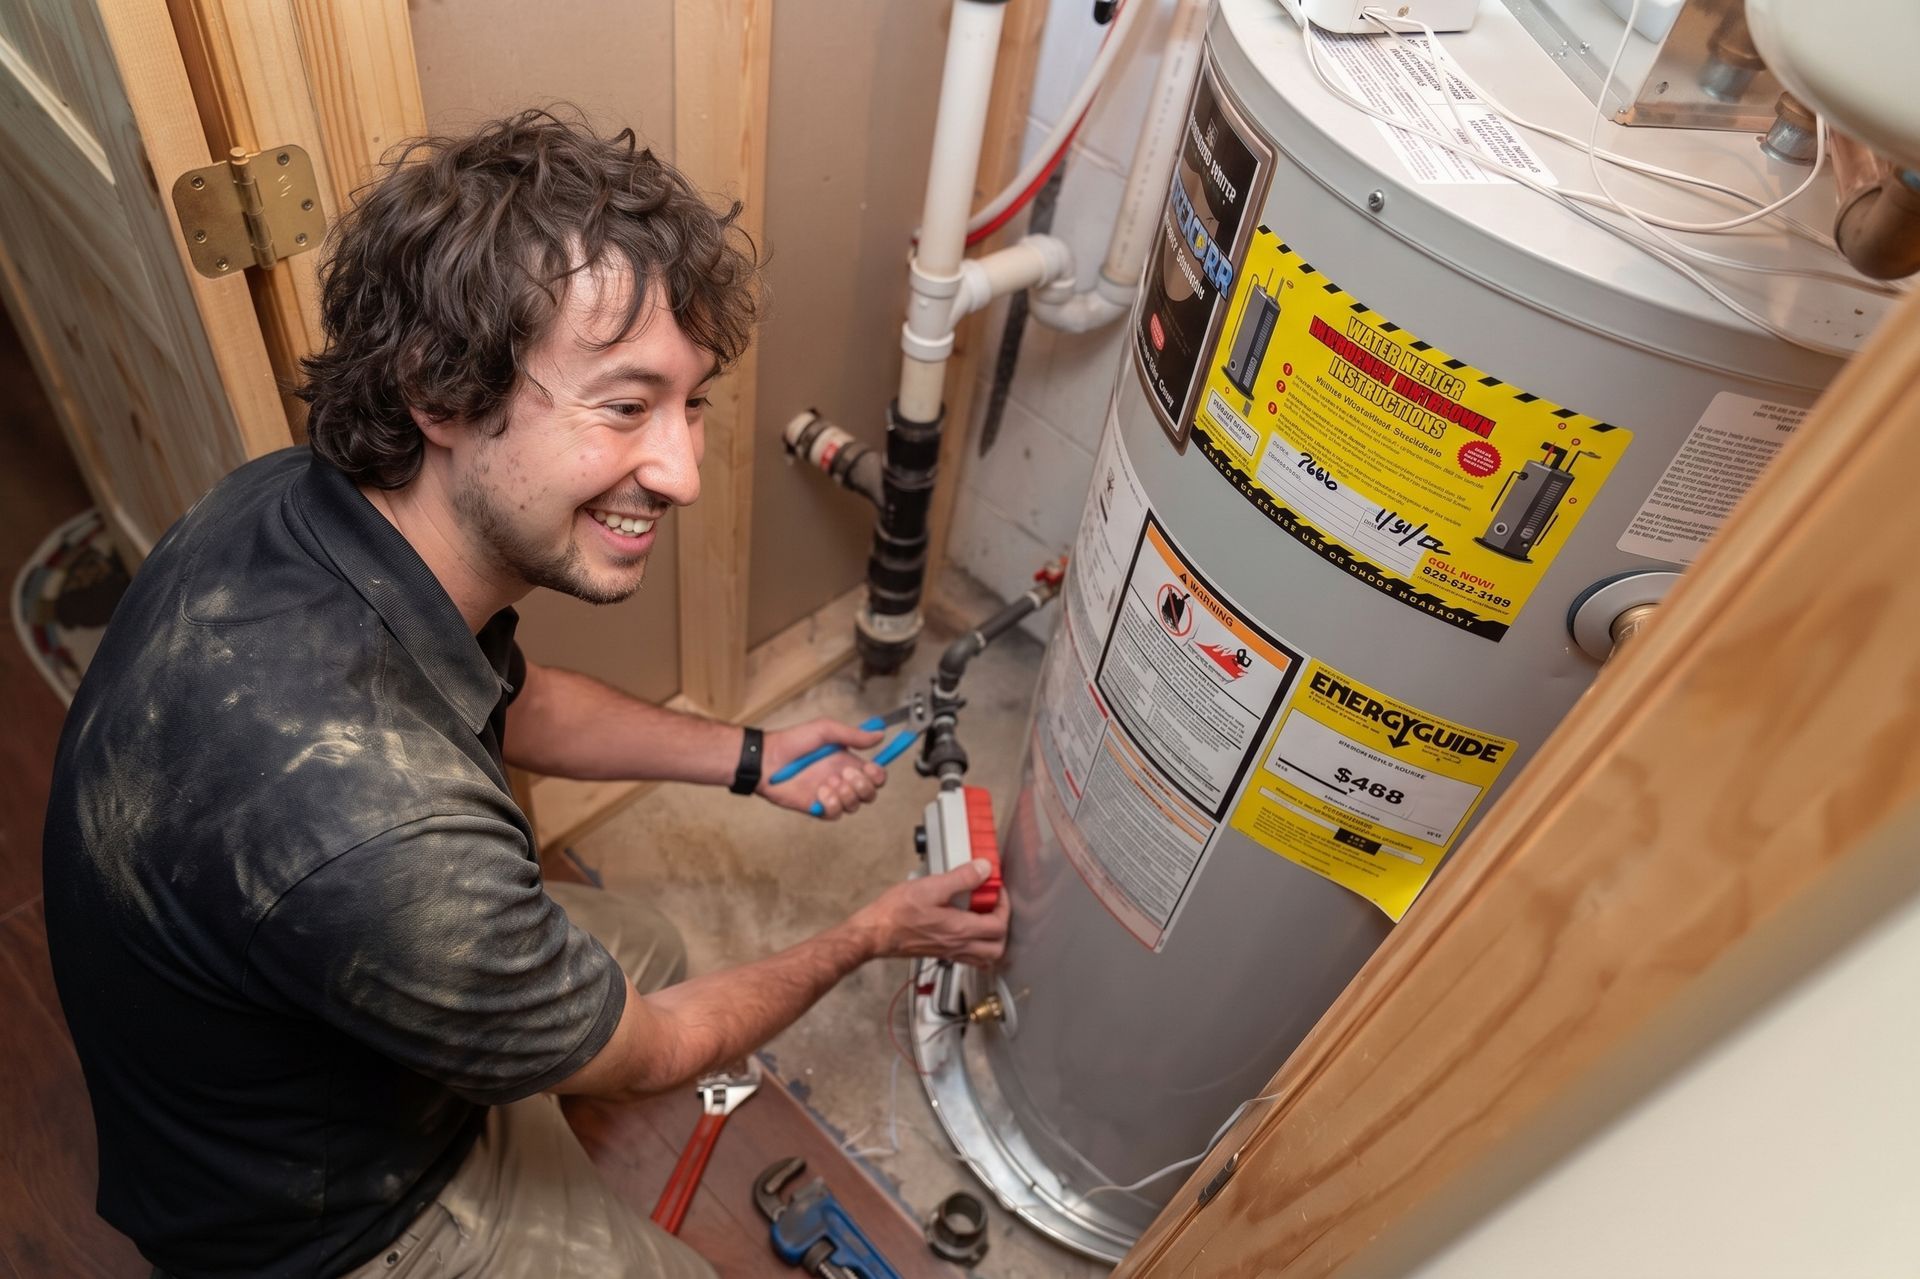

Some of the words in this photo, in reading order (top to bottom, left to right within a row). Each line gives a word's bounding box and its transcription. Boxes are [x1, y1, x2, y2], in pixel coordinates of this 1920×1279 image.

[1347, 316, 1402, 366] WATER
[1328, 355, 1448, 440] INSTRUCTIONS
[1309, 671, 1505, 763] ENERGYGUIDE
[1333, 767, 1405, 805] $468
